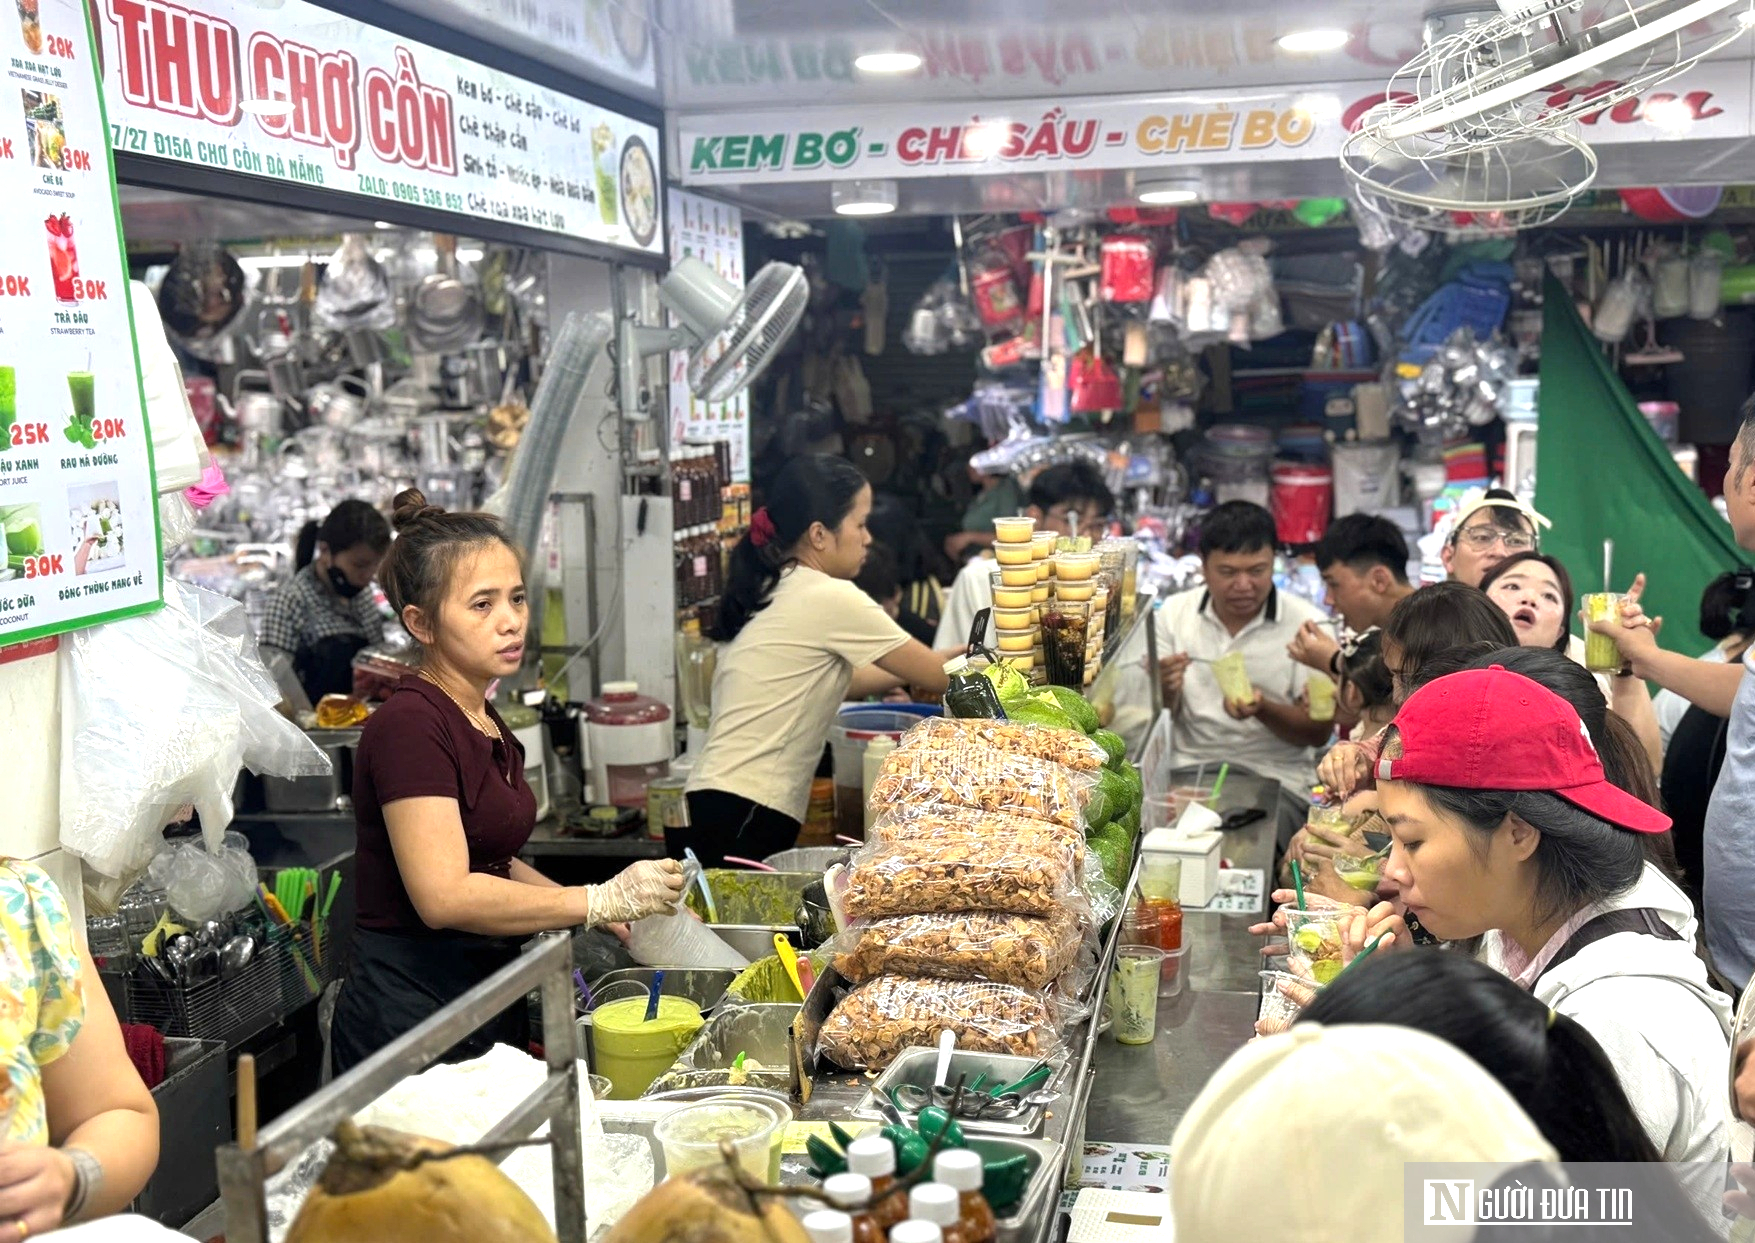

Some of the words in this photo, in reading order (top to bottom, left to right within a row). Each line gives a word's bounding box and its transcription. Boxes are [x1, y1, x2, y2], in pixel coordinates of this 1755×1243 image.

[47, 34, 75, 60] 20K
[108, 0, 242, 125] THU
[250, 31, 358, 170] CHỢ
[364, 45, 458, 176] CỒN
[457, 75, 477, 100] Kem
[459, 115, 479, 137] Chè
[691, 134, 785, 170] KEM
[793, 126, 862, 166] BƠ
[1136, 102, 1236, 152] CHÈ
[63, 147, 91, 171] 30K
[154, 131, 193, 160] Đ15A
[266, 152, 286, 177] ĐÀ
[357, 173, 390, 197] ZALO:
[392, 181, 420, 203] 0905
[73, 278, 108, 300] 30K
[54, 309, 71, 324] TRÀ
[50, 327, 85, 335] STRAWBERRY
[85, 328, 96, 336] TEA
[10, 422, 50, 446] 25K
[92, 418, 126, 440] 20K
[15, 458, 40, 471] XANH
[60, 457, 77, 470] RAU
[79, 453, 91, 467] MÁ
[12, 476, 28, 486] JUICE
[24, 553, 64, 579] 30K
[58, 585, 82, 601] ĐÓNG
[83, 579, 110, 596] THÙNG
[111, 575, 132, 591] MANG
